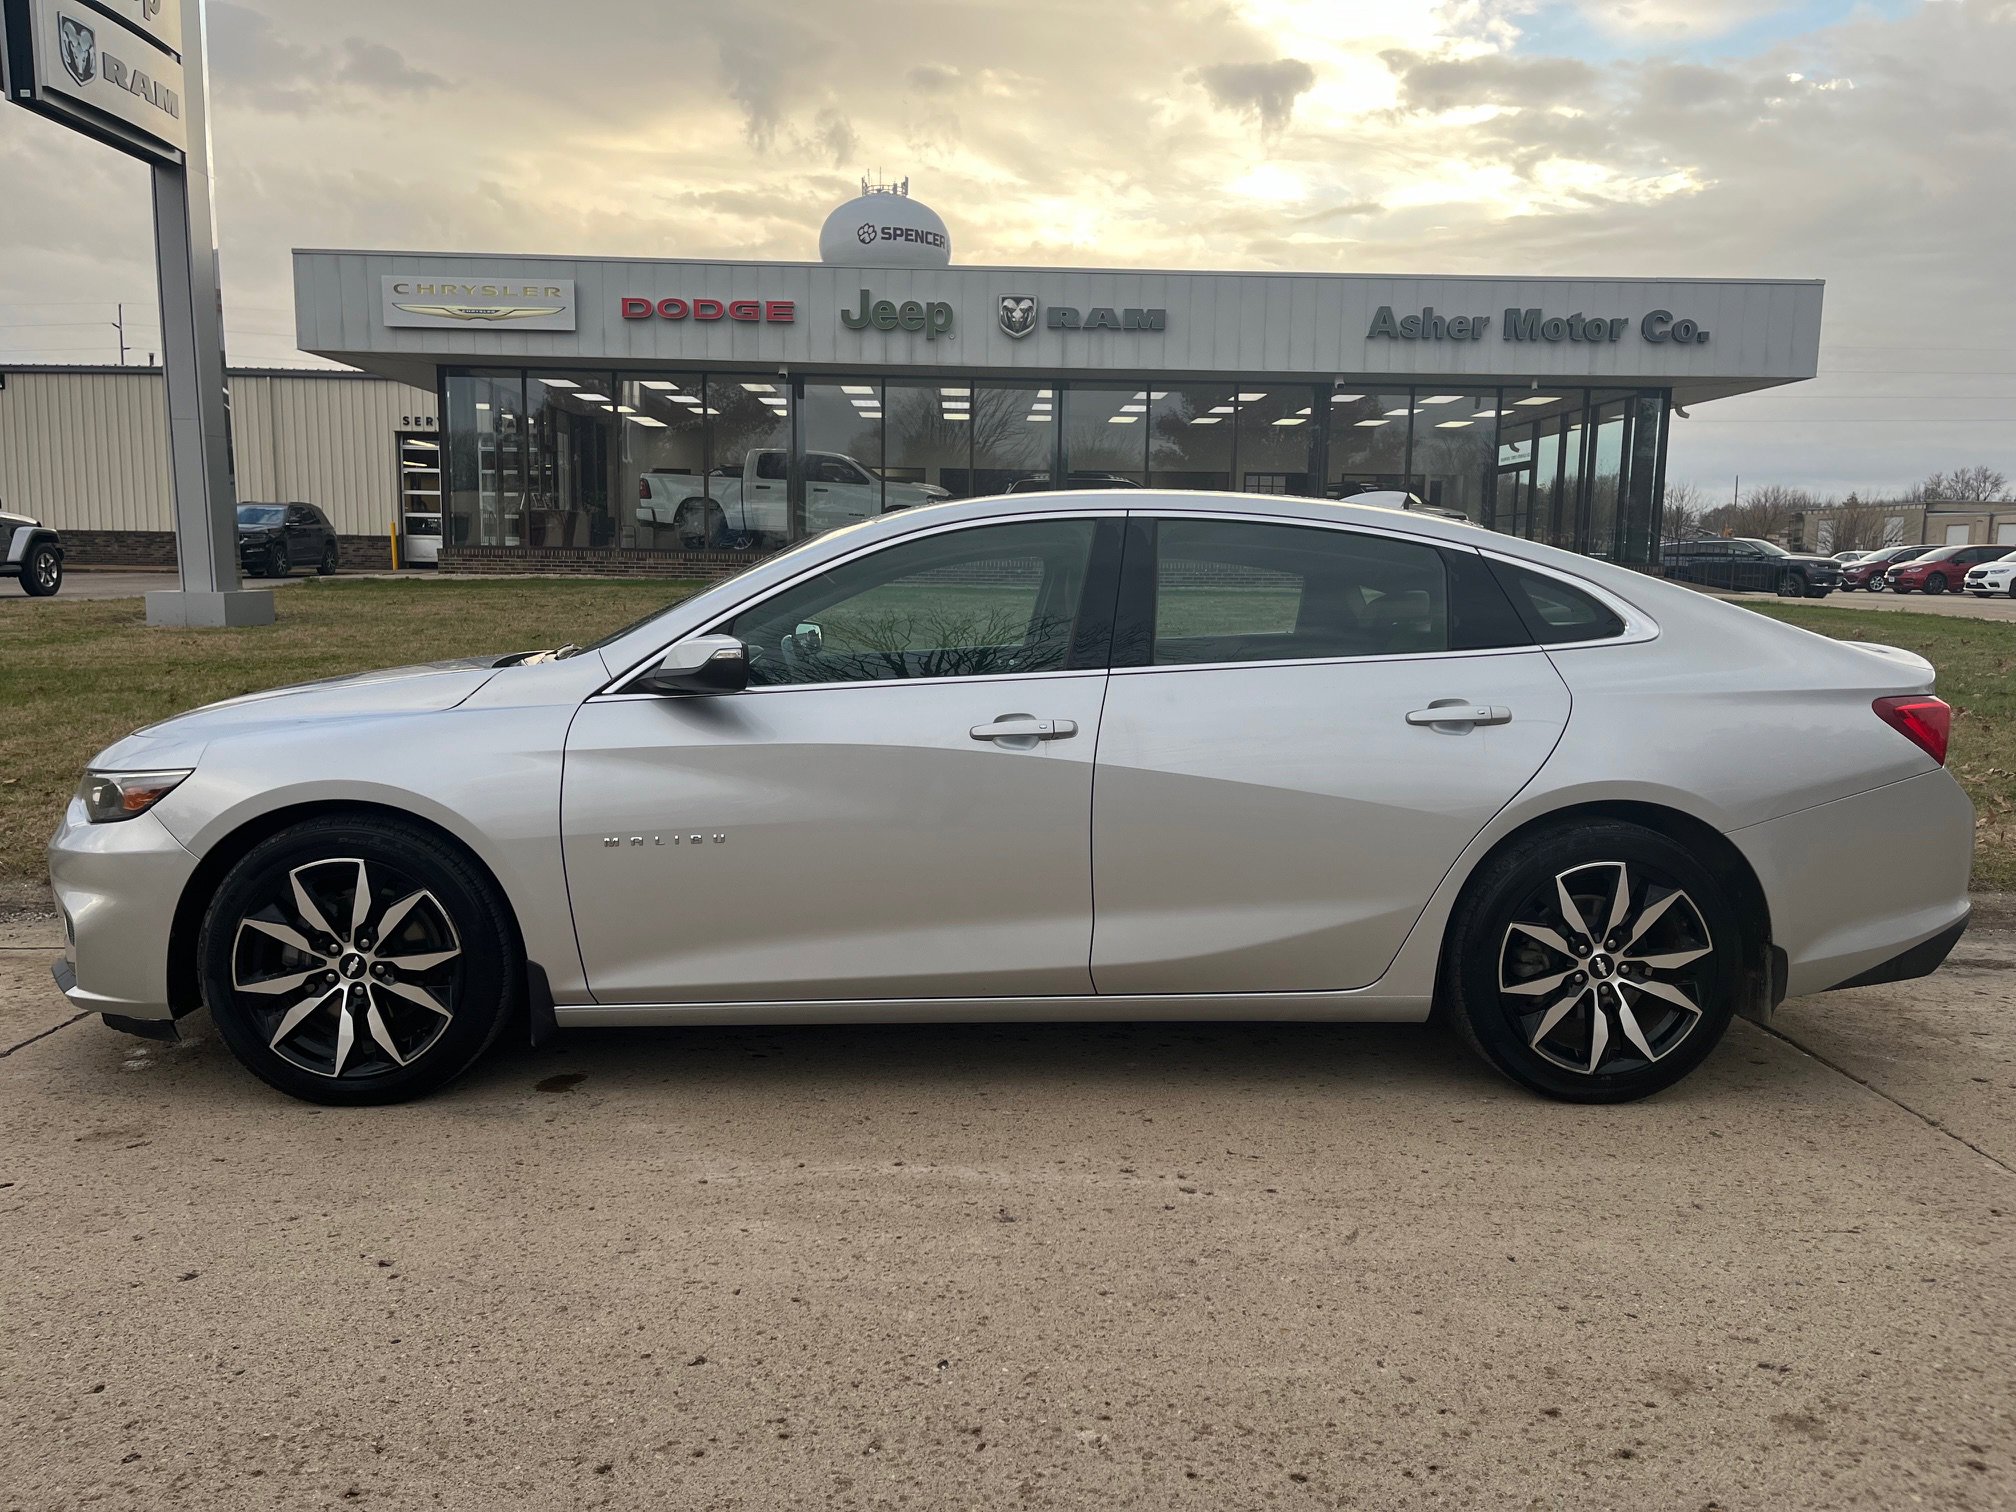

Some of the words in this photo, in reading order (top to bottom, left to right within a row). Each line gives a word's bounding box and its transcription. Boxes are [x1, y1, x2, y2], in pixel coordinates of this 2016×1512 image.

[102, 52, 180, 120] RAM
[880, 226, 946, 249] SPENCER
[393, 283, 562, 298] CHRYSLER
[621, 297, 796, 323] DODGE
[841, 288, 954, 340] Jeep
[1047, 306, 1167, 330] RAM
[1366, 306, 1491, 340] Asher
[1503, 307, 1629, 342] Motor
[1641, 309, 1711, 343] Co.
[402, 415, 440, 427] SER
[603, 833, 726, 847] MALIBU
